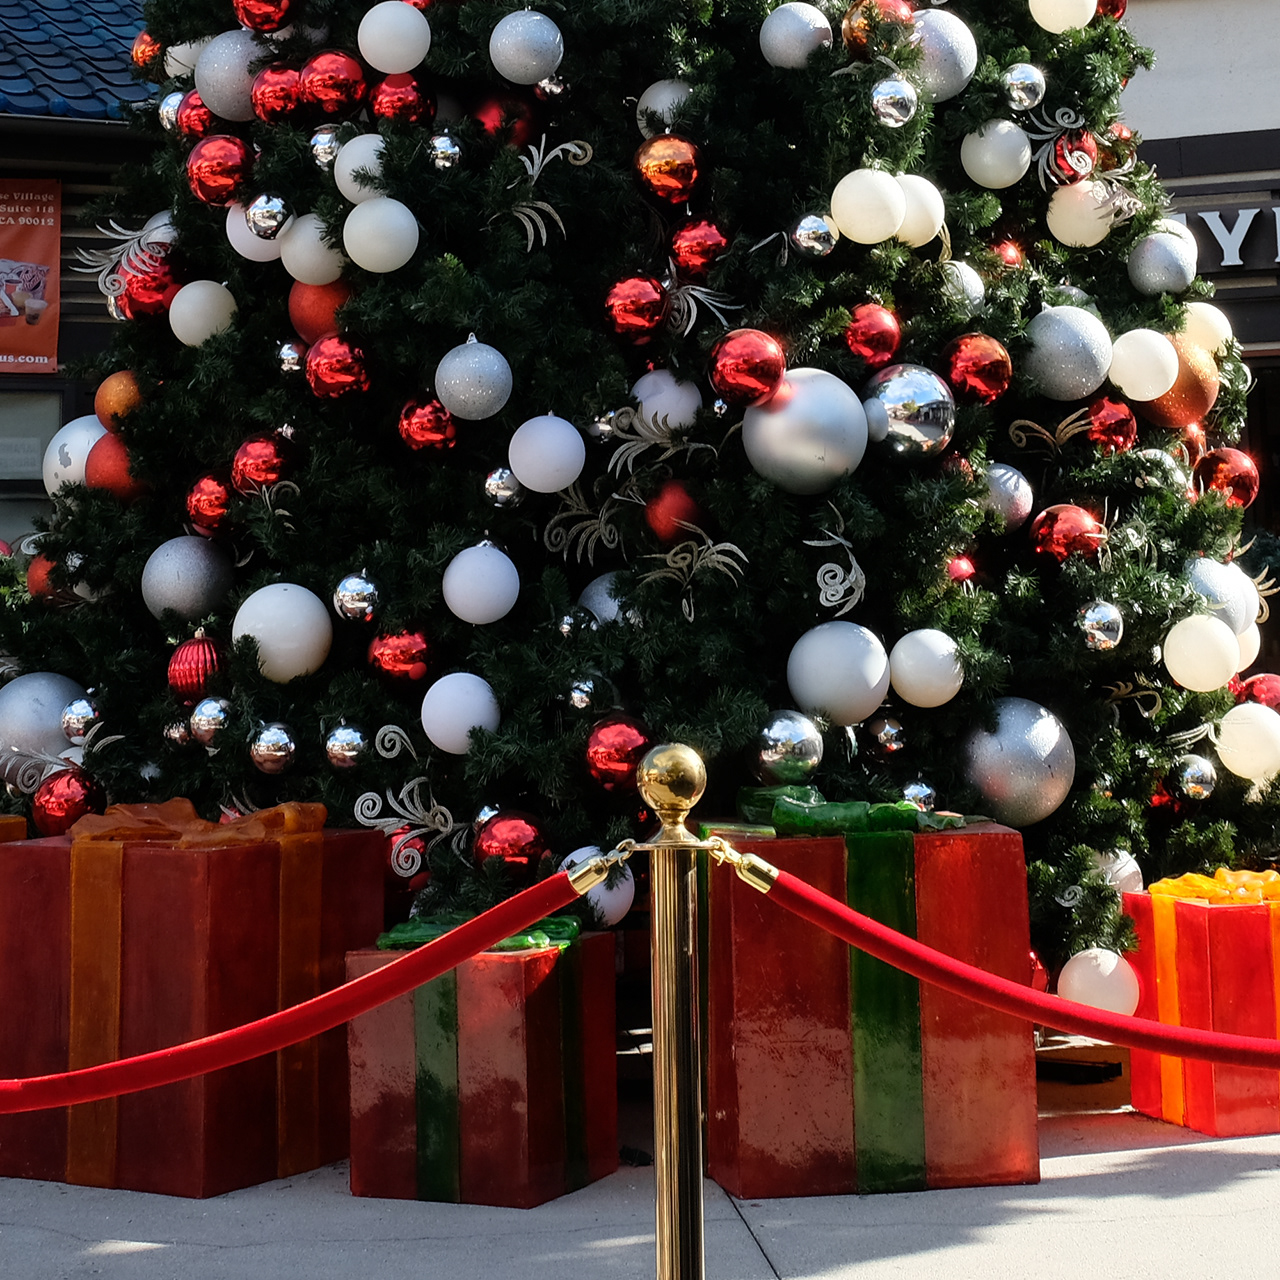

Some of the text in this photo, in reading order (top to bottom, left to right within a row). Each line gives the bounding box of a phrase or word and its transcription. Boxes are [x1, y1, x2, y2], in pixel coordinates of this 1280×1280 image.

[13, 192, 55, 201] Village
[36, 205, 55, 214] 118
[18, 217, 55, 226] 90012
